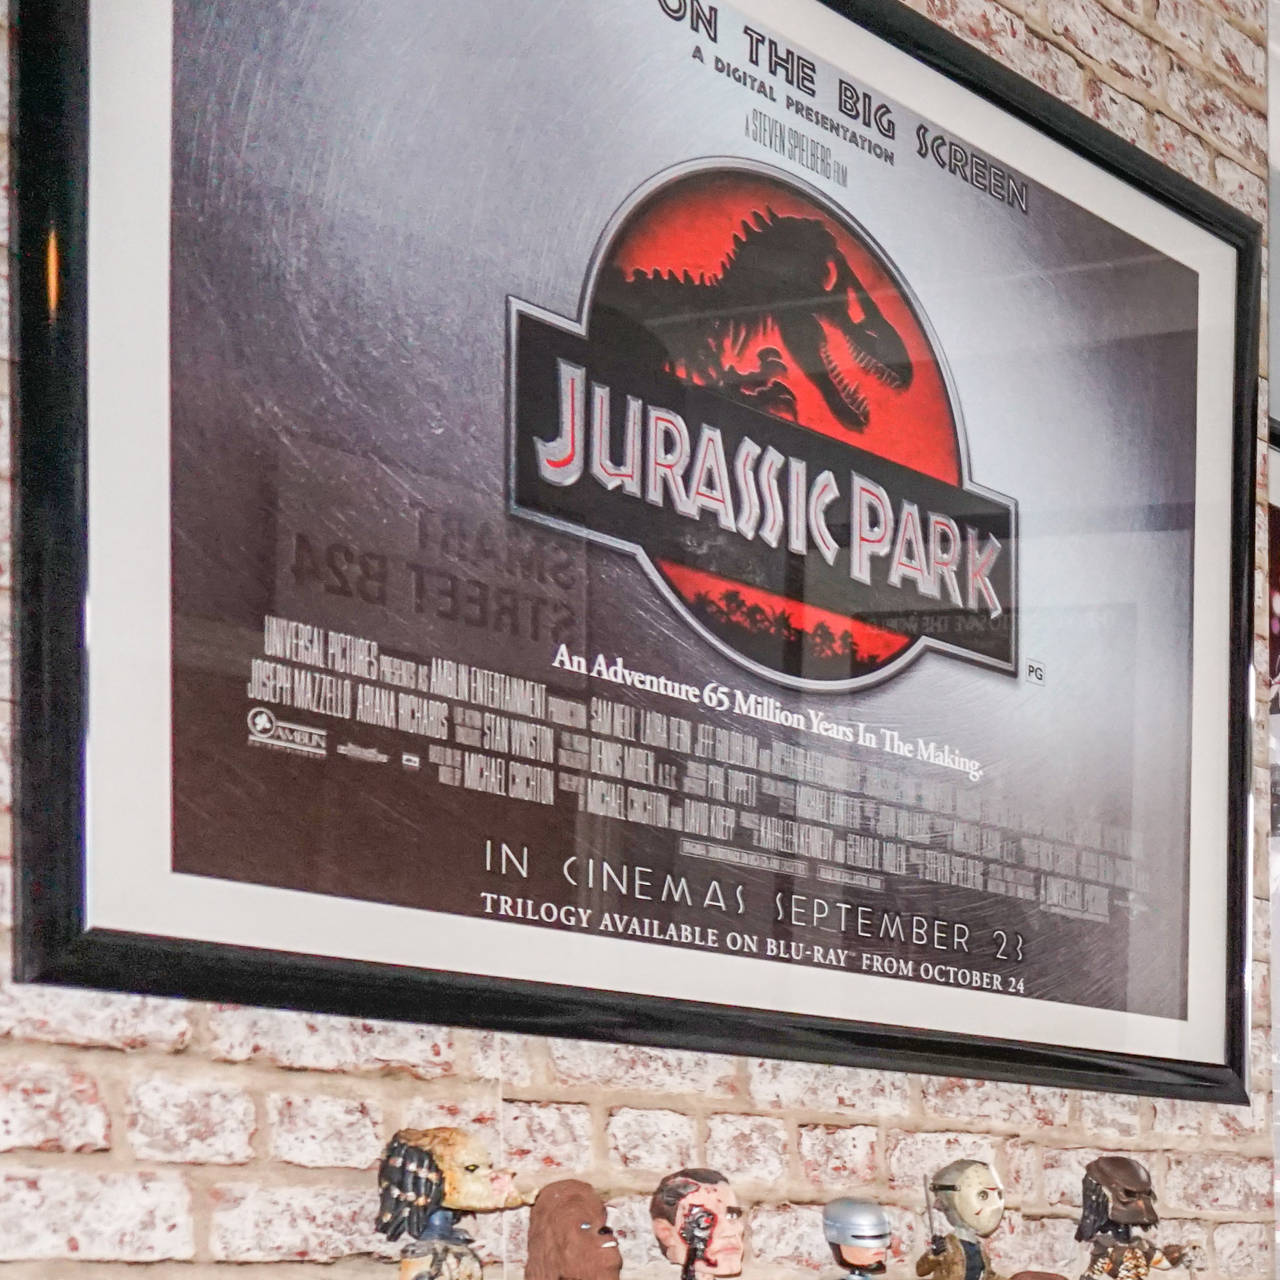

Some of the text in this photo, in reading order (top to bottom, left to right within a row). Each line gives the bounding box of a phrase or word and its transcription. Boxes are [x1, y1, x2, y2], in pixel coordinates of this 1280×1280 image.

[692, 46, 895, 166] A DIGITAL PRESENTATION
[744, 25, 816, 98] THE
[838, 78, 896, 141] BIG
[916, 124, 1029, 213] SCREEN
[752, 108, 786, 156] STEVEN
[788, 127, 831, 180] SPIELBERG
[532, 357, 1001, 619] JURASSIC PARK
[552, 643, 984, 782] An Adventure 65 Million Years In The Making.
[1028, 664, 1044, 682] PG
[480, 891, 593, 929] TRILOGY
[599, 912, 719, 949] AVAILABLE
[726, 931, 758, 953] ON
[862, 952, 914, 979] FROM
[920, 962, 1003, 991] OCTOBER
[1008, 976, 1025, 995] 24
[485, 839, 529, 878] IN
[563, 856, 746, 915] CINEMAS
[776, 892, 969, 953] SEPTEMBER
[993, 930, 1024, 962] 23
